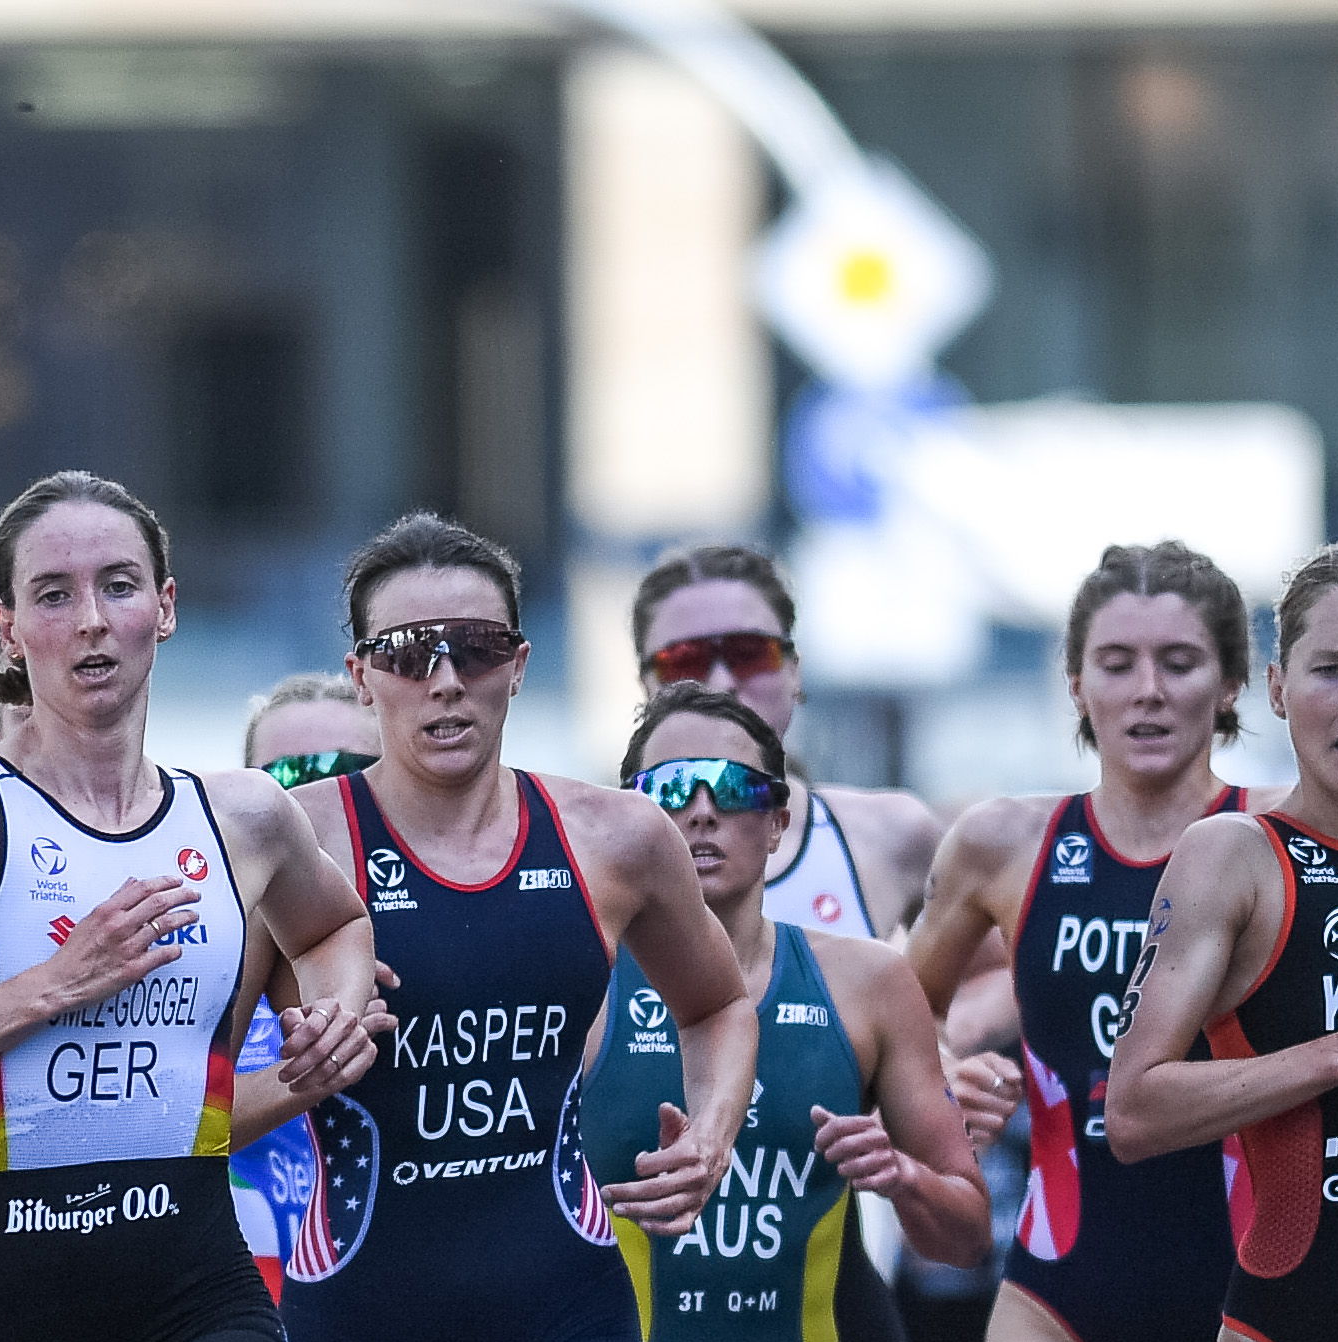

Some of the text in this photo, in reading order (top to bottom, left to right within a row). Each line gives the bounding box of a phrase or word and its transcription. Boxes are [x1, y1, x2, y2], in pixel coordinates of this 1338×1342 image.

[1303, 867, 1335, 876] World
[36, 879, 68, 892] World
[29, 890, 75, 903] Triathlon
[376, 889, 409, 901] World
[371, 900, 418, 913] Triathlon
[393, 1005, 567, 1069] KASPER
[634, 1031, 668, 1043] World
[627, 1042, 676, 1055] Triathlon
[46, 1040, 160, 1102] GER
[416, 1077, 536, 1141] USA
[422, 1149, 548, 1180] VENTUM
[4, 1198, 117, 1234] Bitburger
[673, 1204, 784, 1259] AUS
[678, 1291, 777, 1312] 3T Q+M
